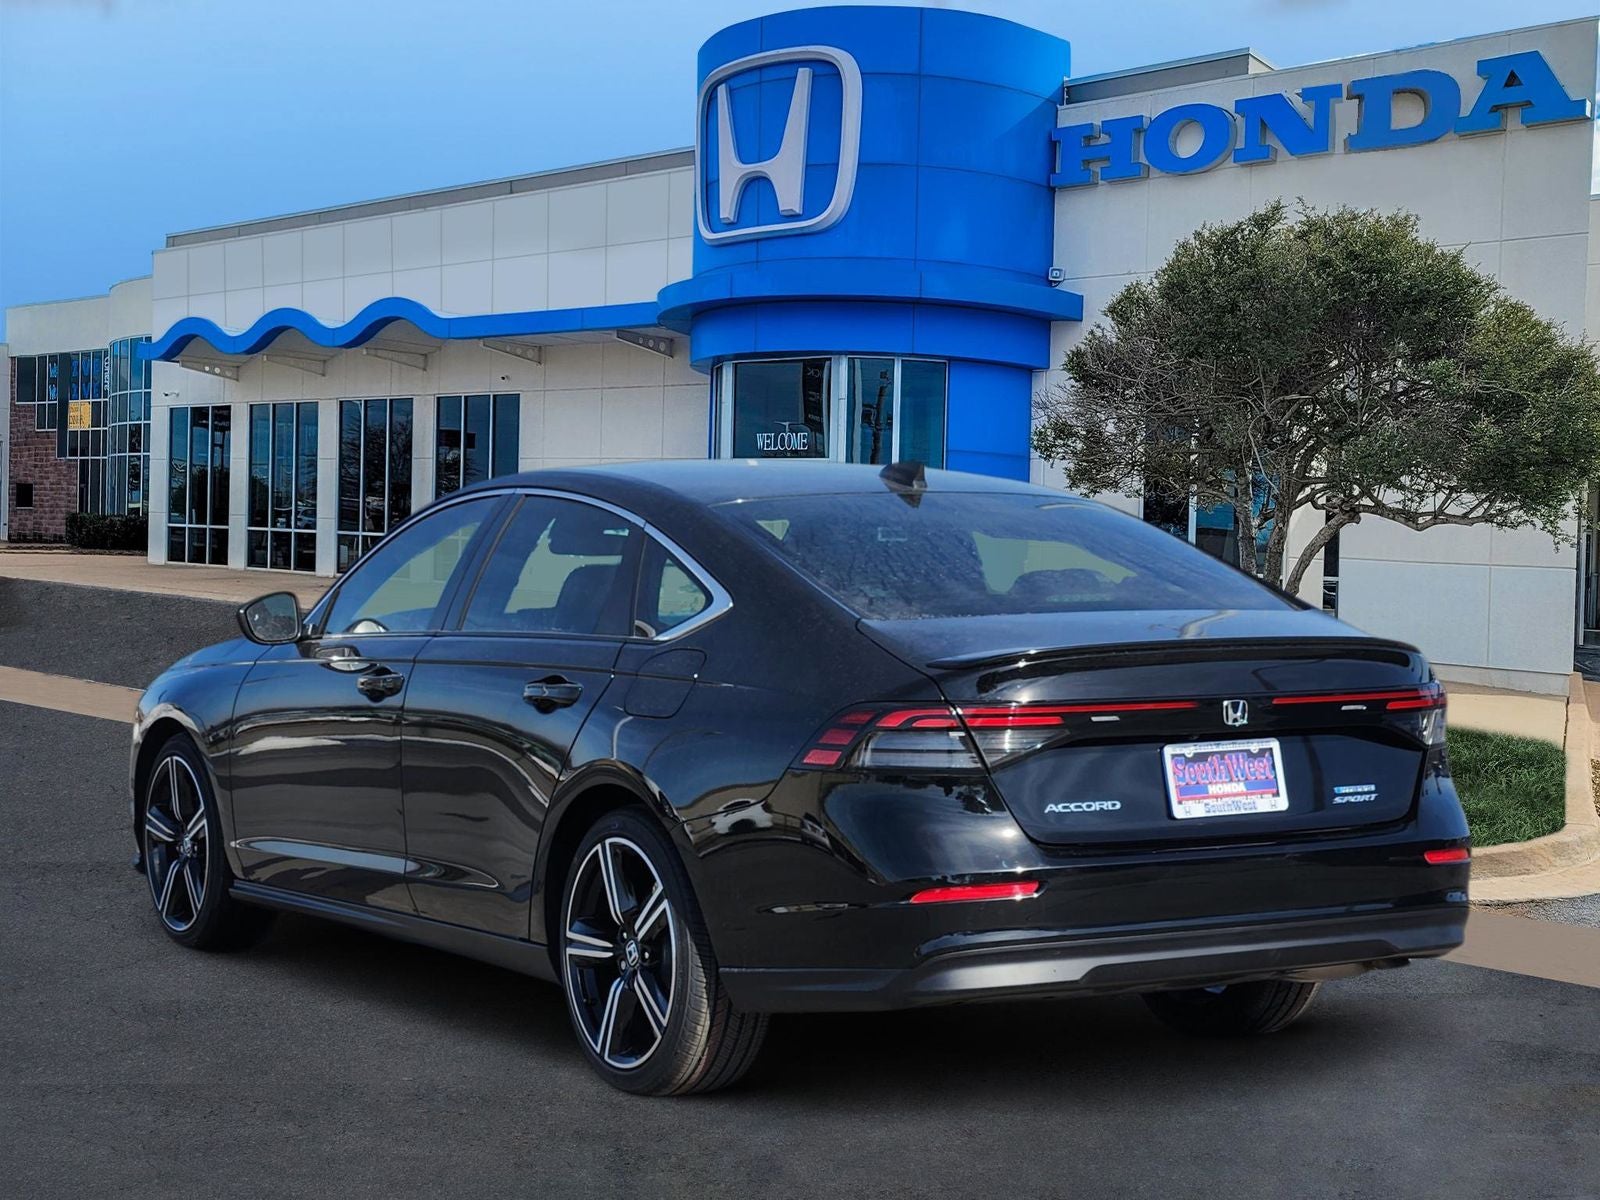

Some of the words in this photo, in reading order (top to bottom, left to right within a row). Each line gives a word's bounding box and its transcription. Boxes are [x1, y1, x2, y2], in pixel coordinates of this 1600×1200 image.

[1050, 50, 1592, 189] HONDA
[756, 432, 808, 451] WELCOME
[1172, 751, 1275, 786] SouthWest
[1207, 782, 1248, 795] HONDA
[1204, 799, 1258, 814] SouthWest
[1332, 793, 1379, 805] SPORT
[1044, 800, 1122, 814] ACCORD
